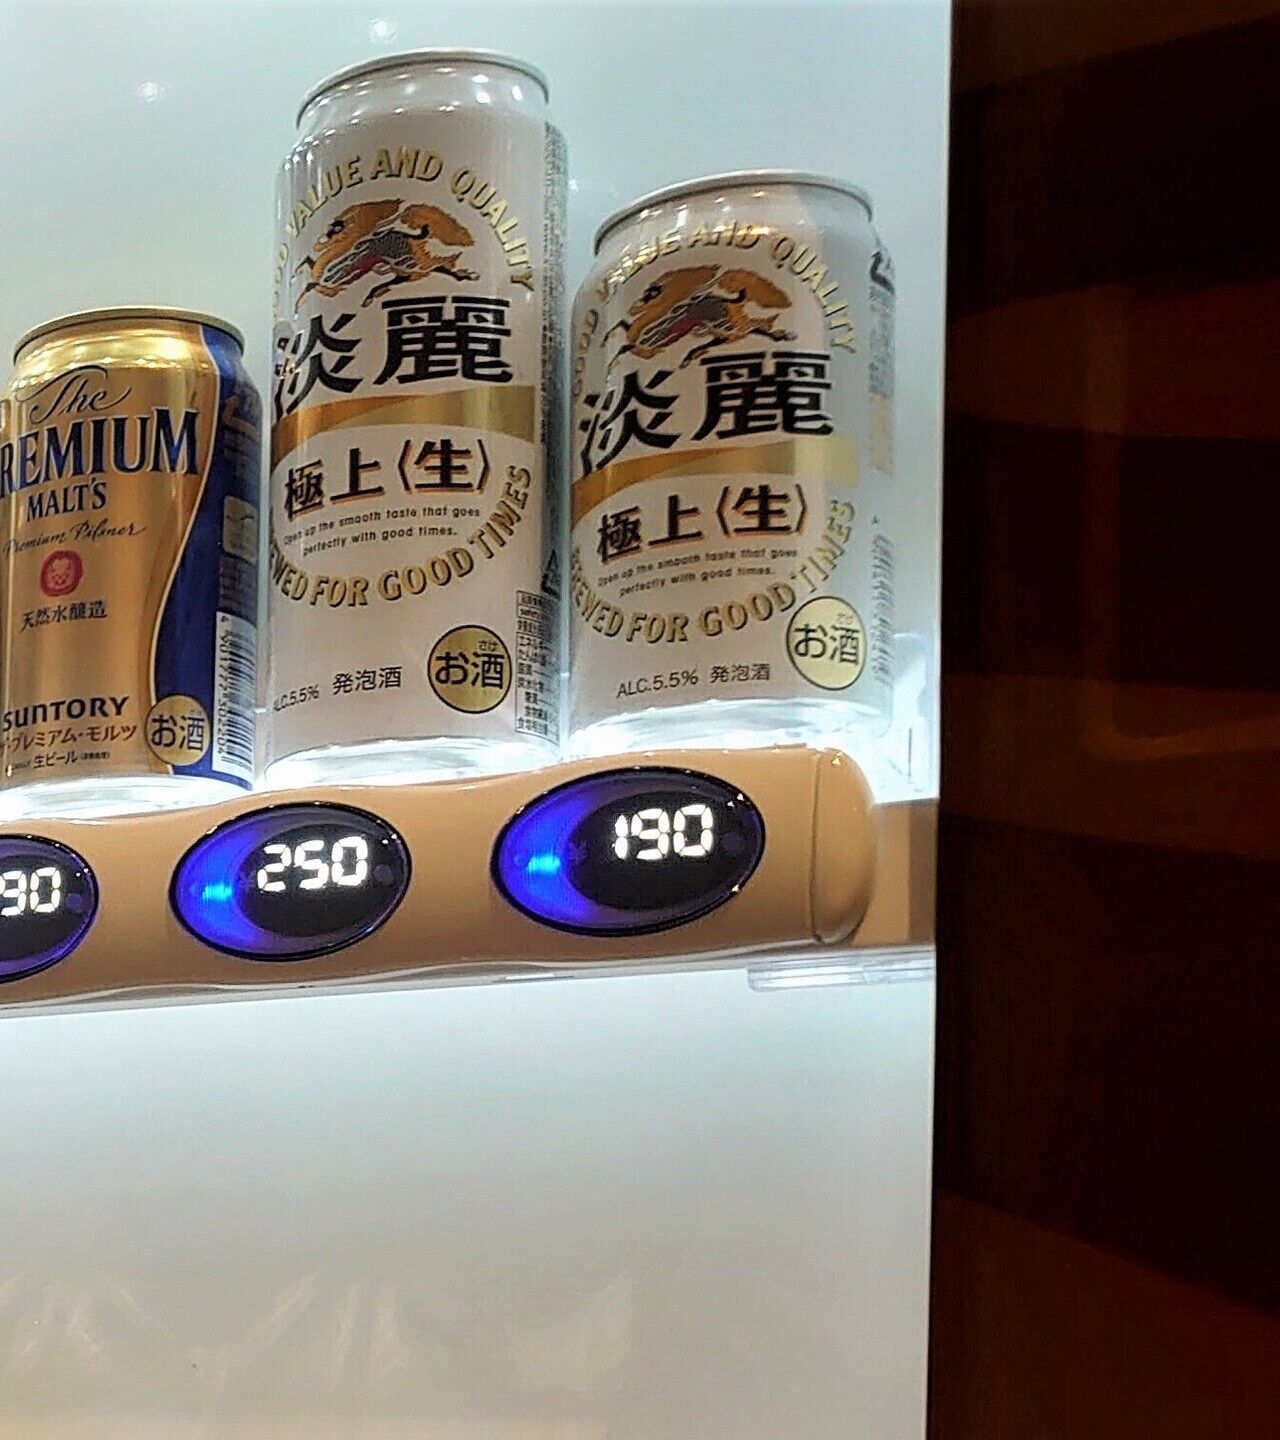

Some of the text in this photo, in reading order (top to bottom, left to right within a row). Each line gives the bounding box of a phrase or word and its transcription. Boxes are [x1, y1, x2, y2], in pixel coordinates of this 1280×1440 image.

[370, 148, 536, 292] AND QUALITY
[772, 235, 857, 354] QUALITY
[14, 364, 133, 426] The
[578, 350, 834, 477] 淡麗
[310, 464, 533, 609] FOR GOOD TIMES
[339, 506, 481, 528] smooth taste that goes
[351, 529, 377, 544] with
[381, 527, 414, 543] good
[626, 581, 798, 645] FOR GOOD
[434, 650, 505, 690] お酒
[709, 663, 771, 684] 発泡酒
[794, 622, 860, 667] お酒
[331, 665, 403, 696] 発泡酒
[150, 714, 206, 753] お酒
[613, 803, 714, 862] 190
[256, 834, 368, 893] 250
